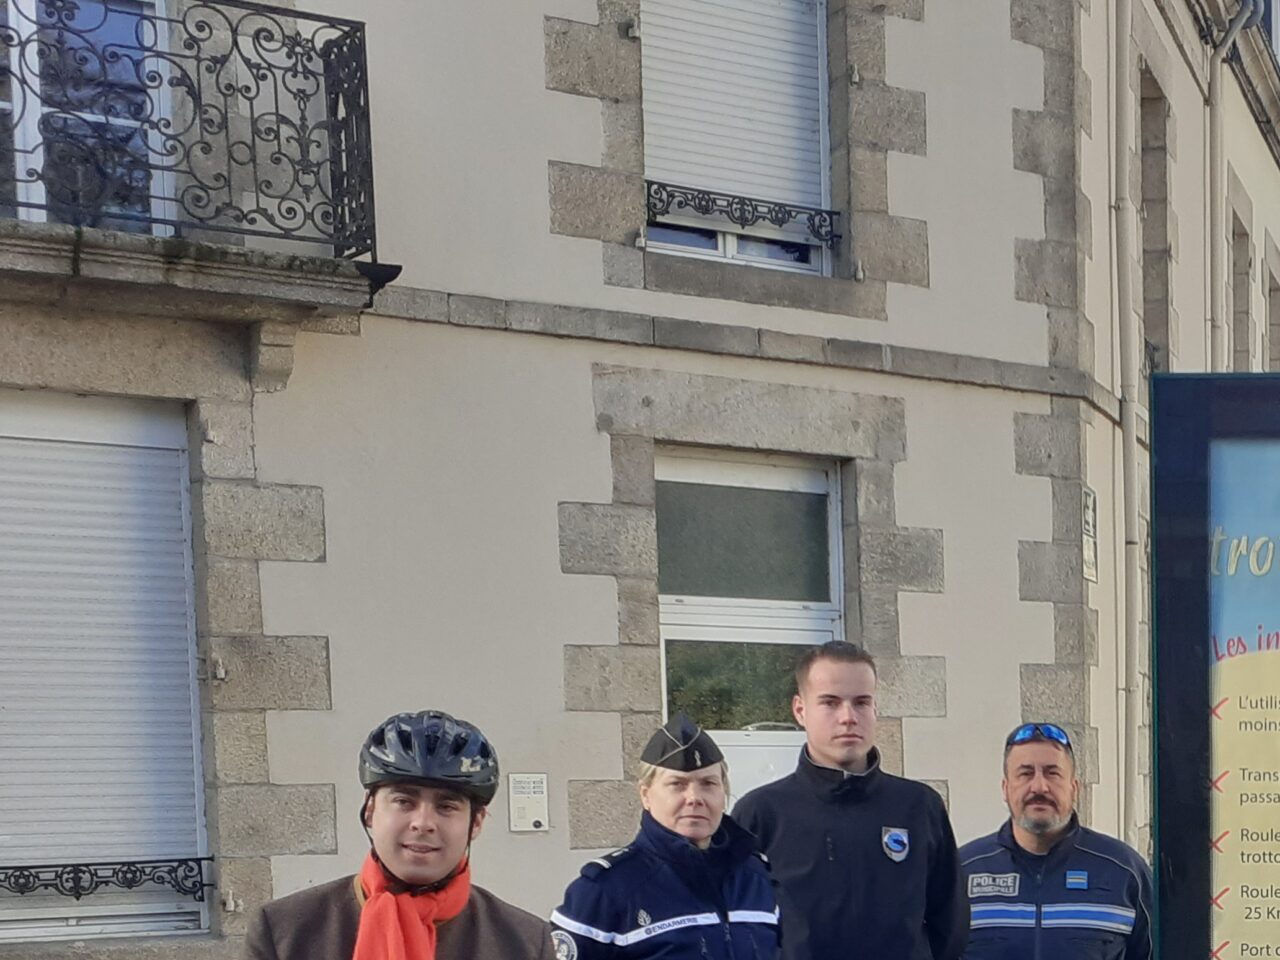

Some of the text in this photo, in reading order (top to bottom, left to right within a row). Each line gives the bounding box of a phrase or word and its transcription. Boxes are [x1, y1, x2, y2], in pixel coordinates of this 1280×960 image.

[1212, 633, 1248, 662] Les
[972, 876, 1014, 887] POLICE
[1244, 906, 1262, 920] 25
[1240, 942, 1271, 957] Port
